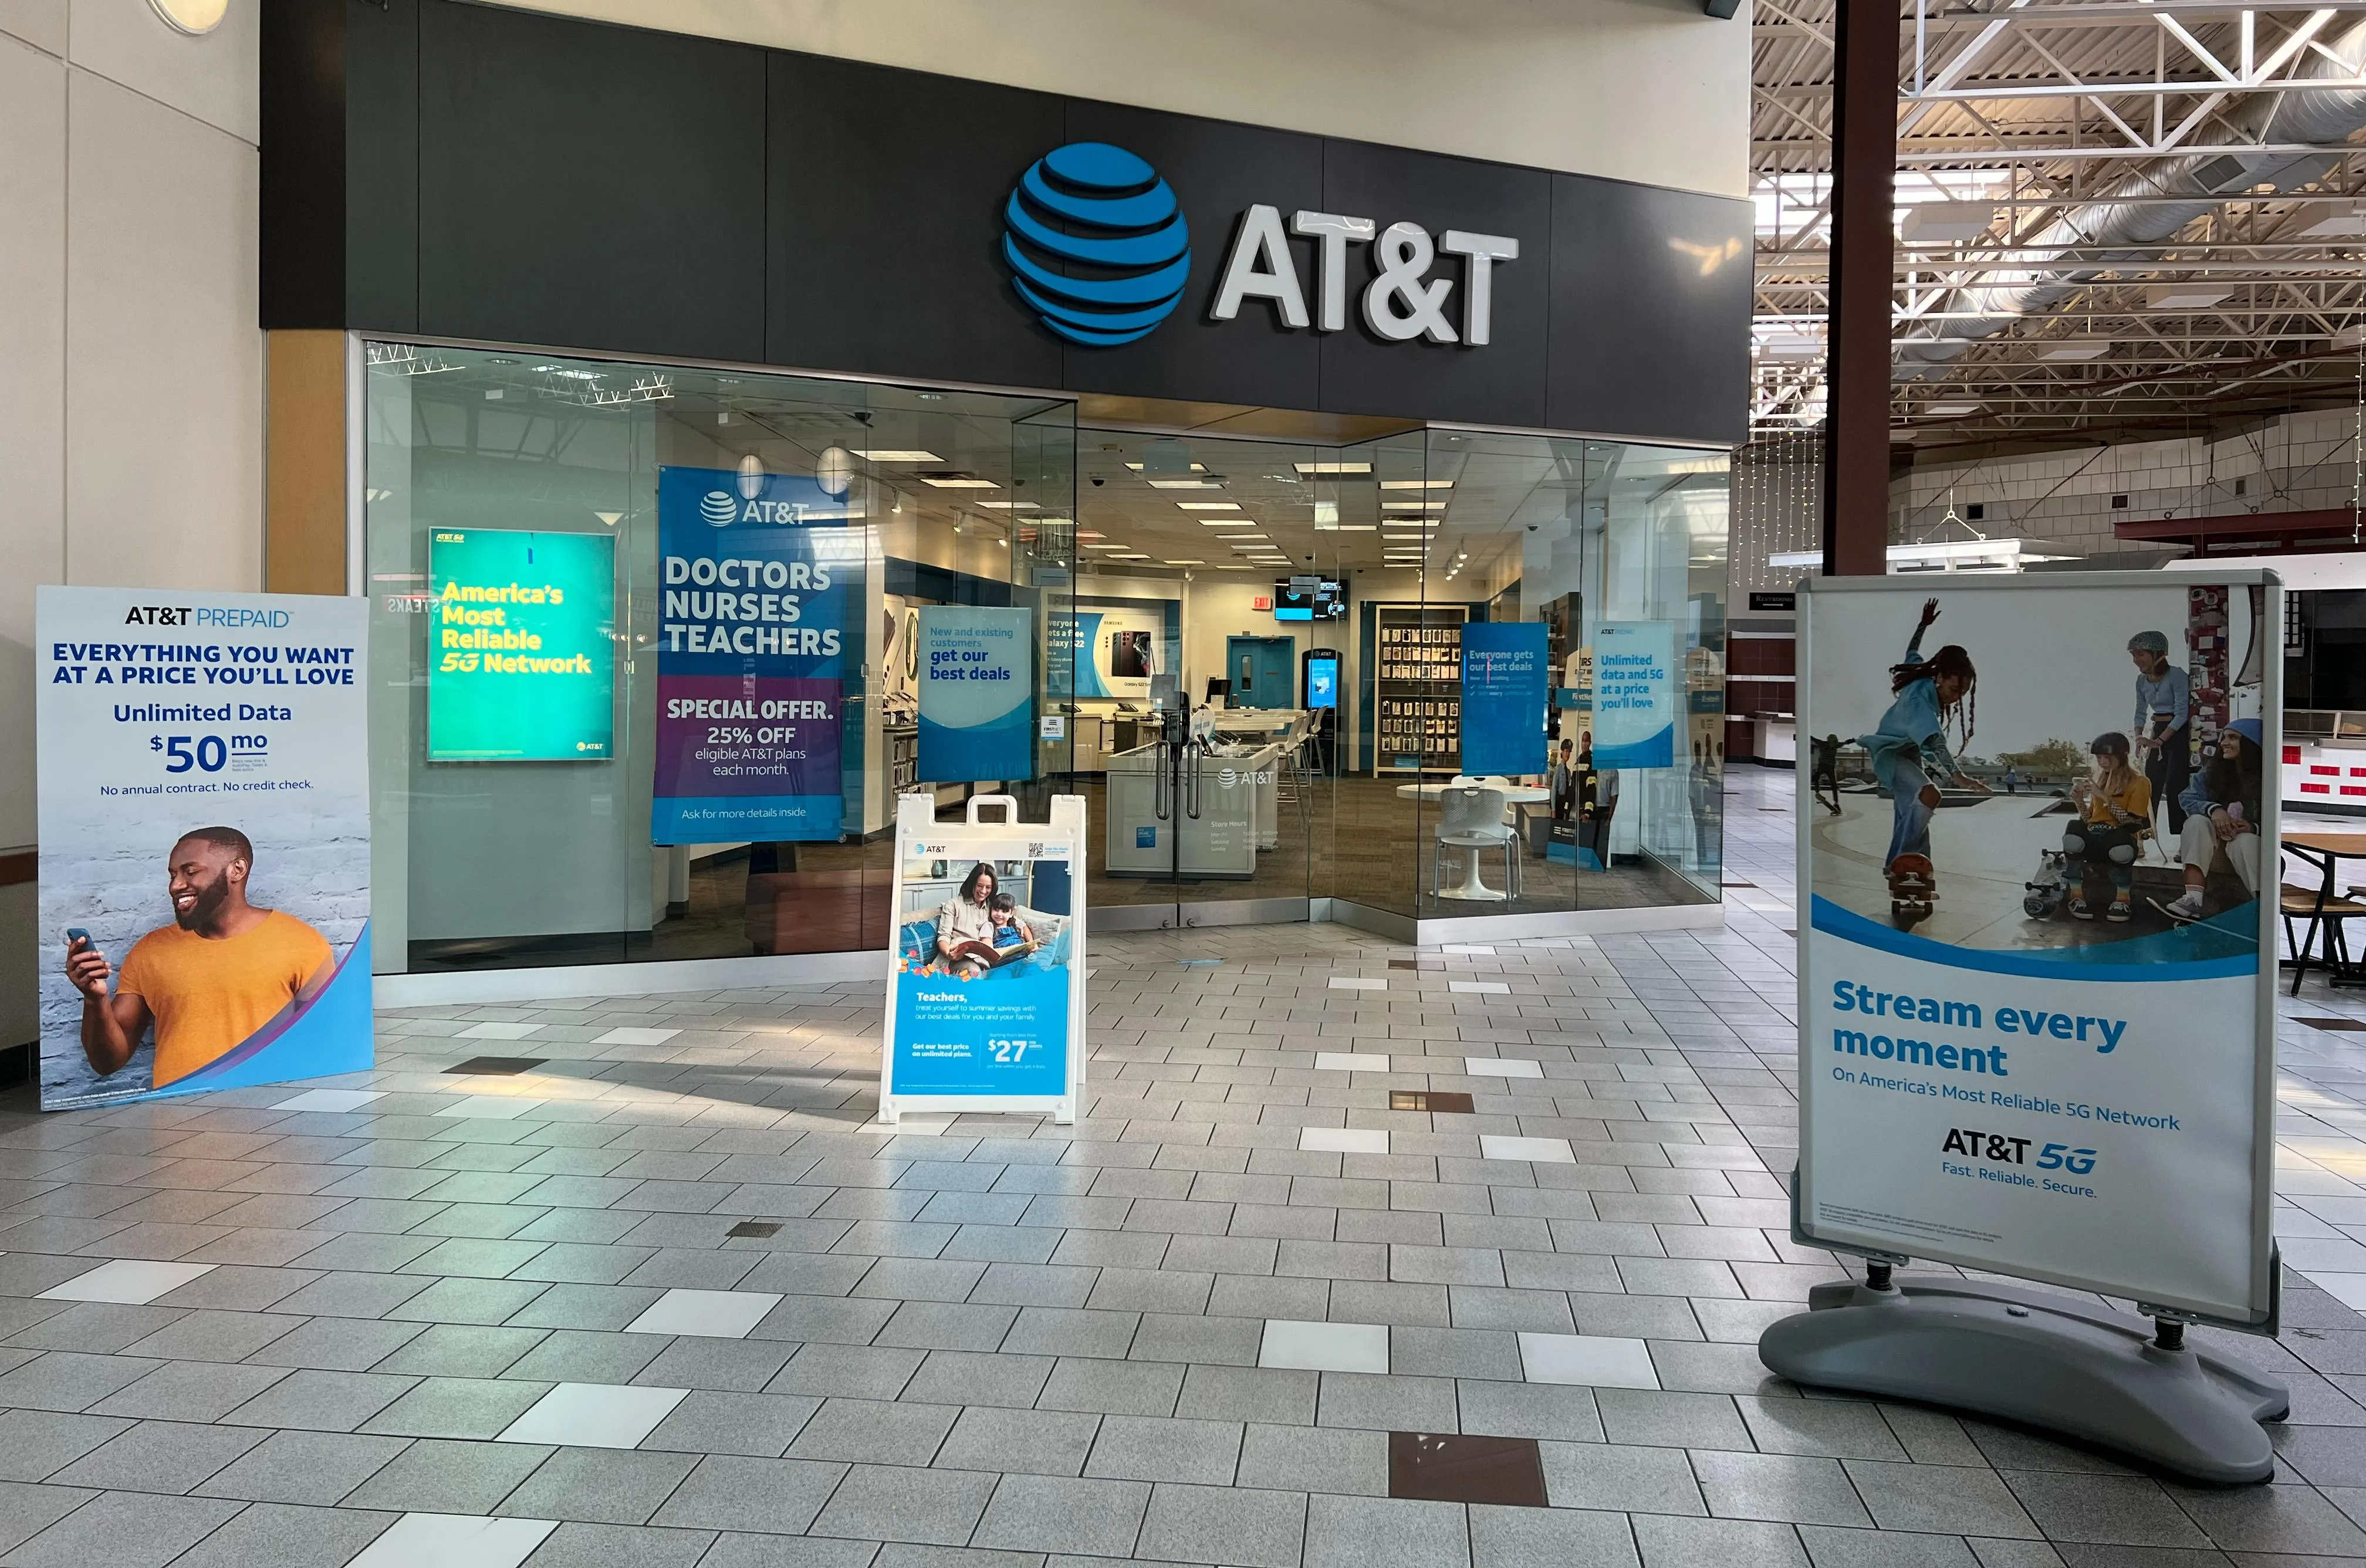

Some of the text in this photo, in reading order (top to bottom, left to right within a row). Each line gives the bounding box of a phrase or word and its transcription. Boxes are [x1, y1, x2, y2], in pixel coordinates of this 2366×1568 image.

[1209, 204, 1519, 346] AT&T
[742, 500, 809, 525] AT&T
[666, 556, 830, 590] DOCTORS
[442, 582, 563, 604] America's
[666, 590, 800, 622] NURSES
[1255, 597, 1268, 608] EXIT
[125, 606, 289, 628] AT&T PREPAID
[442, 606, 505, 626] Most
[442, 629, 542, 650] Reliable
[665, 624, 841, 655] TEACHERS
[930, 627, 1013, 638] New and existing
[1047, 639, 1069, 648] alaxy
[54, 643, 354, 664] EVERYTHING YOU WANT
[931, 650, 988, 665] get our
[1469, 650, 1533, 661] Everyone gets
[1601, 654, 1652, 665] Unlimited
[440, 653, 592, 674] 5G Network
[1488, 662, 1507, 671] best
[1509, 662, 1532, 671] deals
[53, 667, 354, 685] AT A PRICE YOU'LL LOVE
[931, 667, 1010, 680] best deals
[1601, 669, 1625, 680] data
[1628, 668, 1647, 679] and
[1650, 669, 1663, 679] 5G
[1601, 682, 1650, 697] at a price
[114, 704, 291, 722] Unlimited Data
[667, 699, 833, 719] SPECIAL OFFER.
[1601, 697, 1653, 712] you'll love
[232, 734, 268, 749] mo
[708, 728, 796, 744] 25% OFF
[695, 748, 806, 762] eligible AT&T plans
[713, 763, 789, 775] each month.
[101, 779, 314, 796] No annual contract. No credit check.
[1241, 772, 1274, 785] AT&T
[682, 809, 699, 819] Ask
[702, 809, 716, 819] for
[747, 809, 777, 817] details
[917, 992, 967, 1003] Teachers,
[1833, 981, 2127, 1053] Stream every
[988, 1039, 1027, 1062] $27
[1834, 1029, 2008, 1076] moment
[1833, 1067, 2181, 1131] On America's Most Reliable 5G Network
[1942, 1128, 2097, 1174] AT&T 5G
[1942, 1163, 2097, 1198] Fast. Reliable. Secure.
